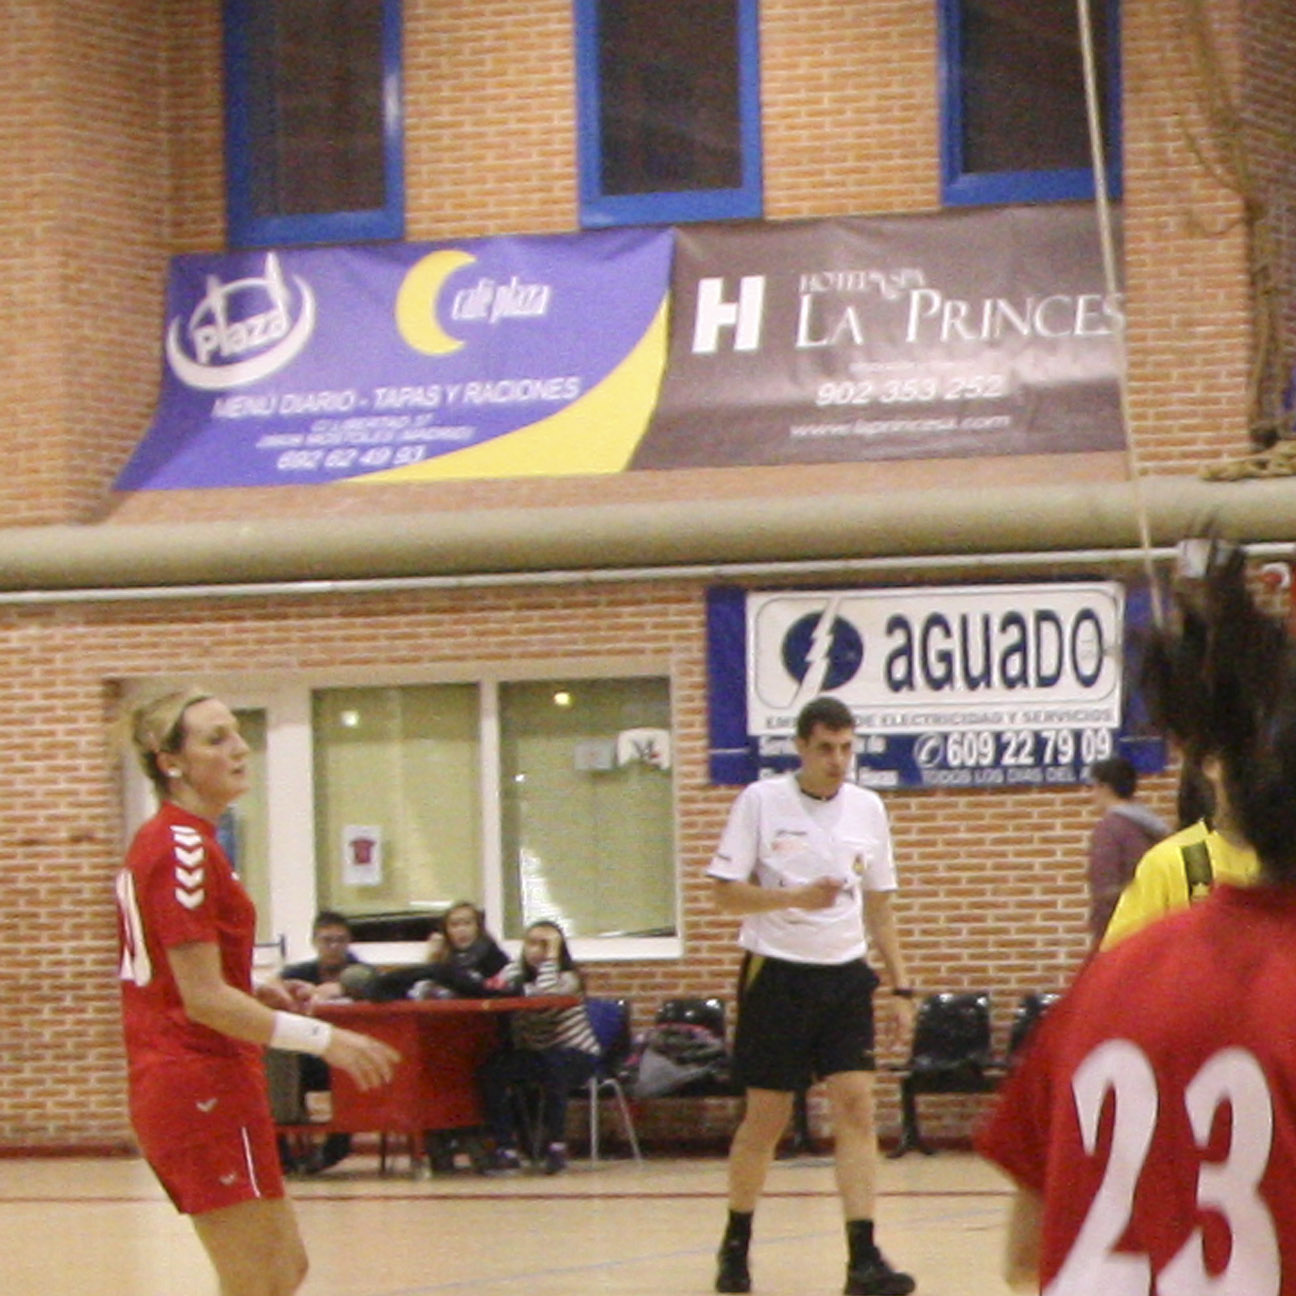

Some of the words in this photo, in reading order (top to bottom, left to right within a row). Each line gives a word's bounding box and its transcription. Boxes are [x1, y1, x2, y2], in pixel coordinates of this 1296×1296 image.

[691, 275, 766, 354] H
[278, 387, 356, 415] DIARIO
[372, 384, 443, 410] TAPAS
[445, 383, 463, 404] Y
[463, 376, 582, 405] RACIONES
[814, 379, 874, 407] 902
[878, 377, 938, 404] 353
[943, 374, 1008, 401] 252
[945, 730, 996, 767] 609
[1001, 729, 1036, 766] 22
[1041, 728, 1076, 765] 79
[1080, 726, 1113, 764] 09
